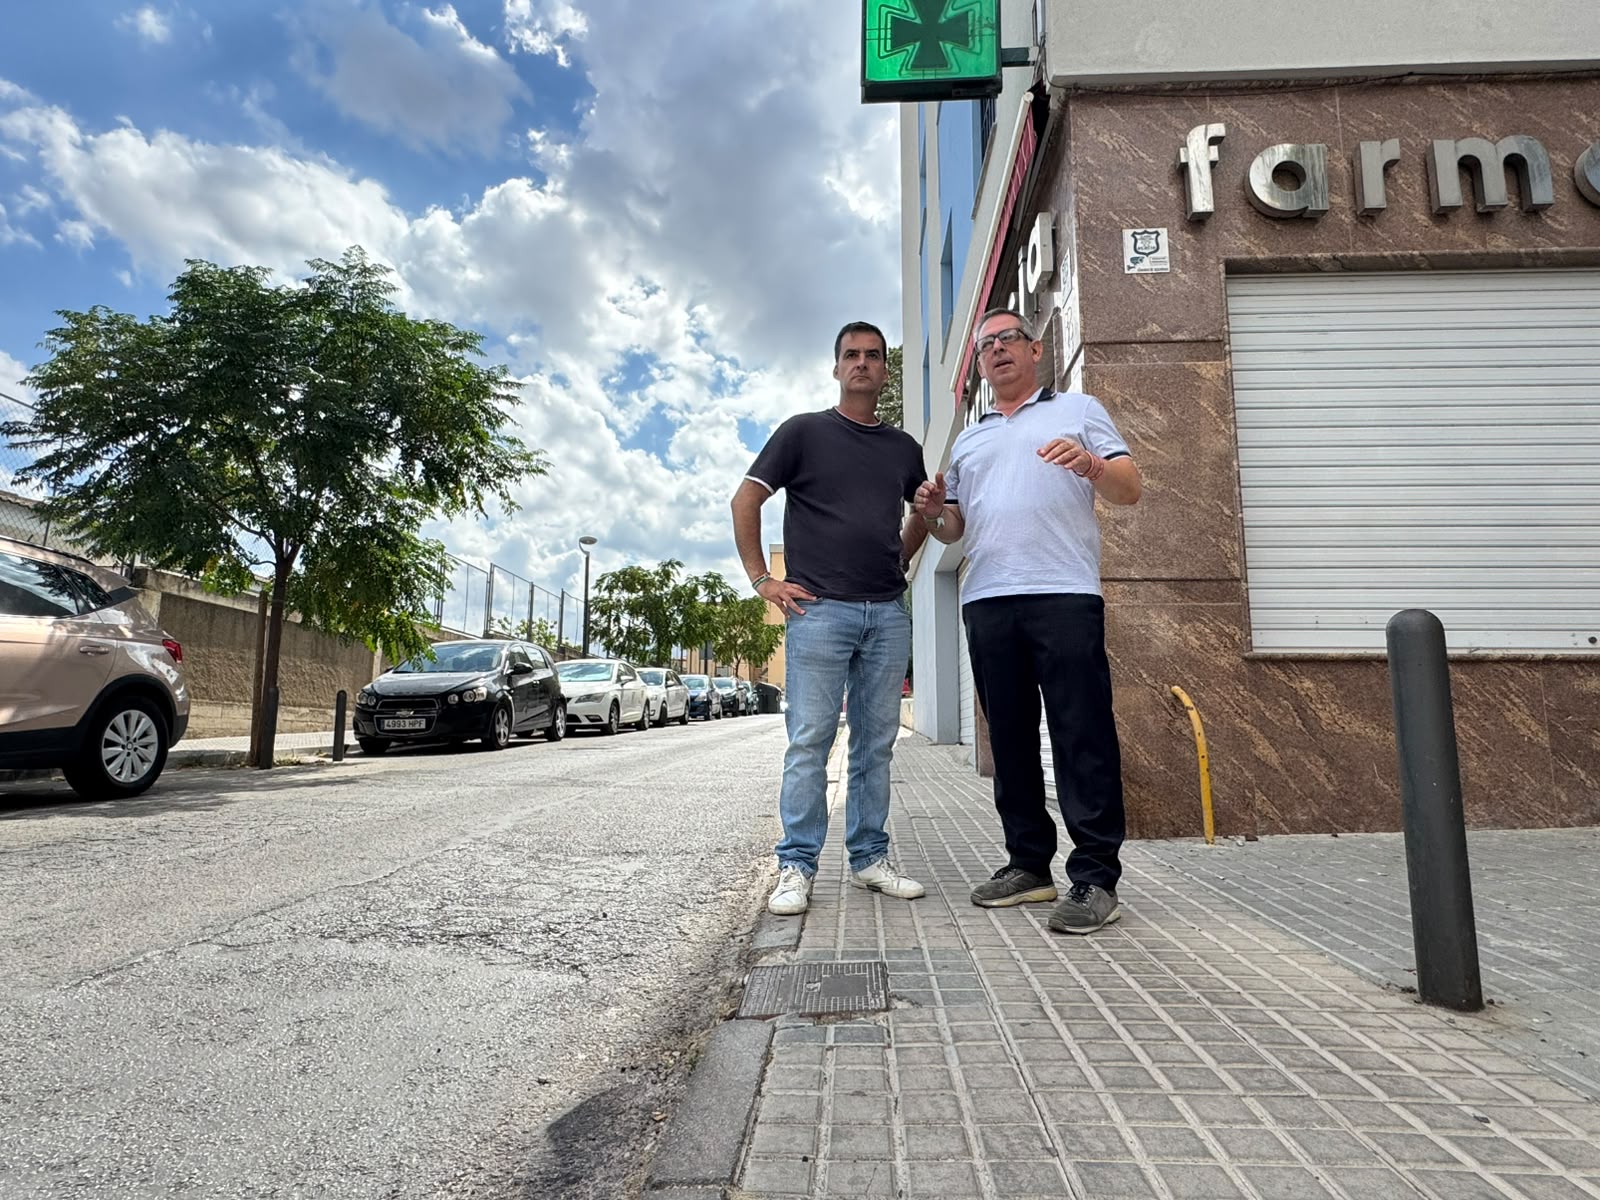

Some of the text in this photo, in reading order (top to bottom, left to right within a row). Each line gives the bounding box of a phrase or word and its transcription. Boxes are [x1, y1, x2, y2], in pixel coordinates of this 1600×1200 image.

[1177, 122, 1600, 222] farm
[386, 720, 424, 728] 4993 HPF
